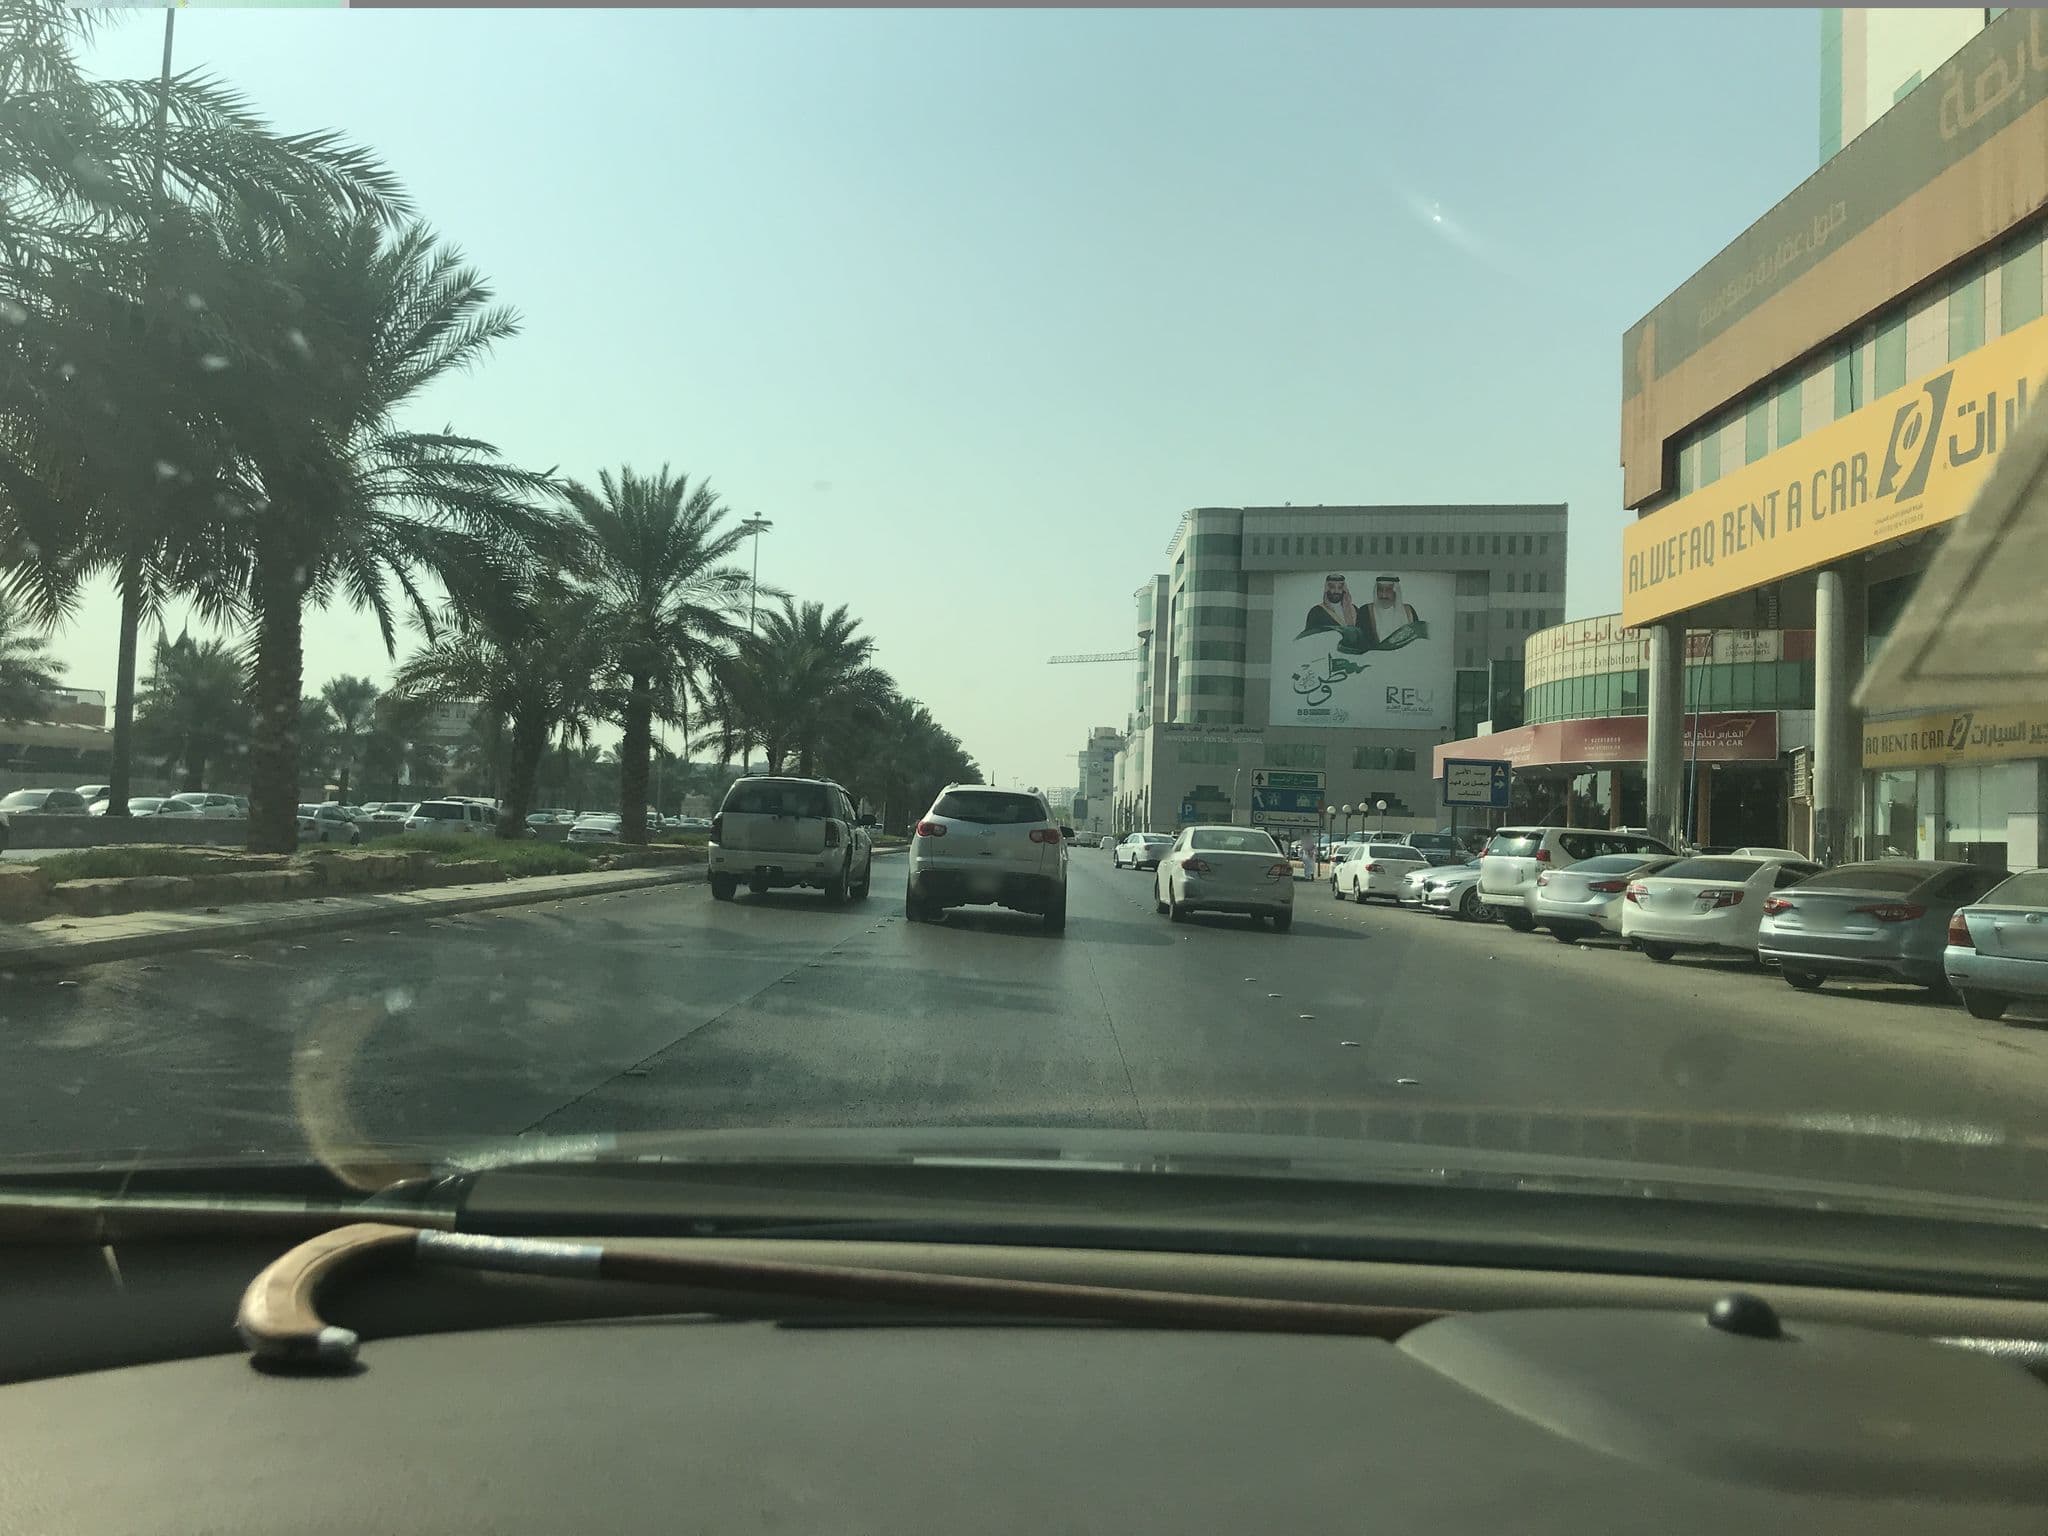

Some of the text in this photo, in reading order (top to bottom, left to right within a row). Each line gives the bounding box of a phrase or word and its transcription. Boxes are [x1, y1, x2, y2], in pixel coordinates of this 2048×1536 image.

[1629, 519, 1715, 594] ALWEFAQ
[1722, 490, 1780, 558] RENT
[1787, 480, 1802, 532] A
[1812, 451, 1868, 521] CAR
[1595, 654, 1640, 668] Exhibitions
[1726, 739, 1743, 747] CAR
[1881, 733, 1908, 753] RENT
[1911, 733, 1918, 751] A
[1922, 729, 1944, 750] CAR
[1185, 804, 1193, 815] P
